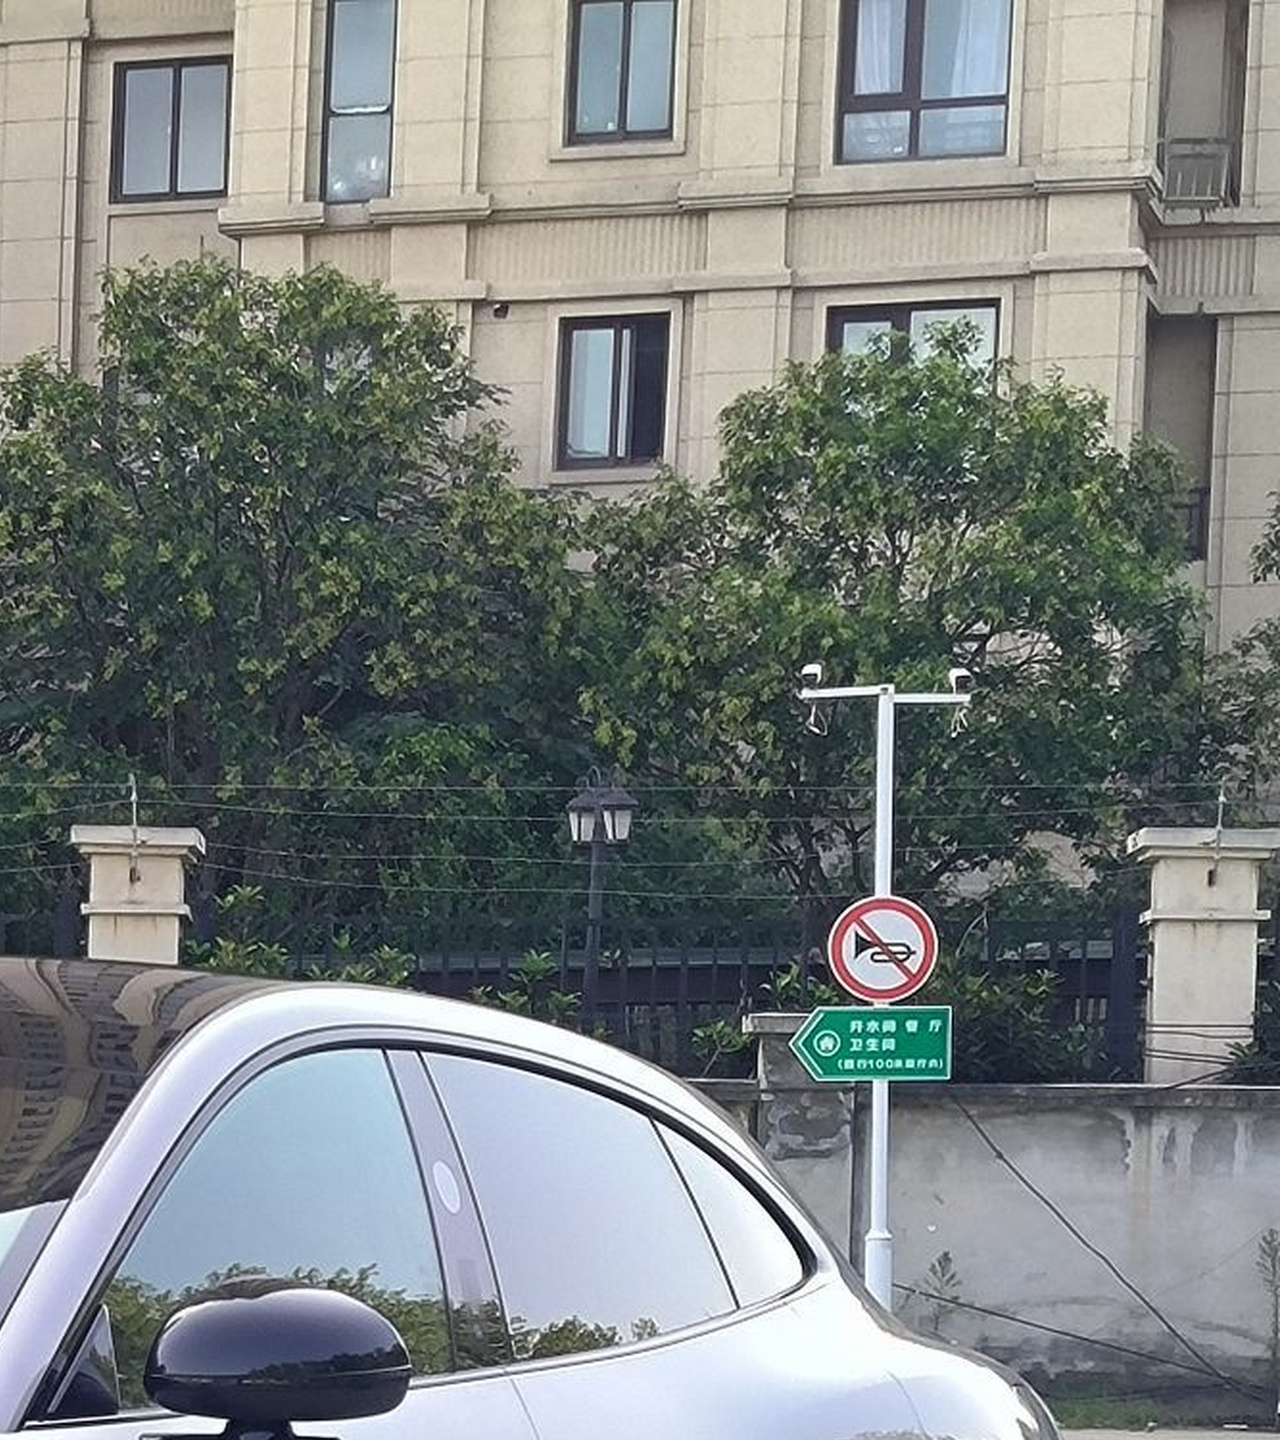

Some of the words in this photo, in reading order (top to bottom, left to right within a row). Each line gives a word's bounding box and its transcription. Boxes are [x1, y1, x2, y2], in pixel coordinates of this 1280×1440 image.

[850, 1019, 897, 1033] 开水间
[850, 1038, 896, 1051] 卫生间
